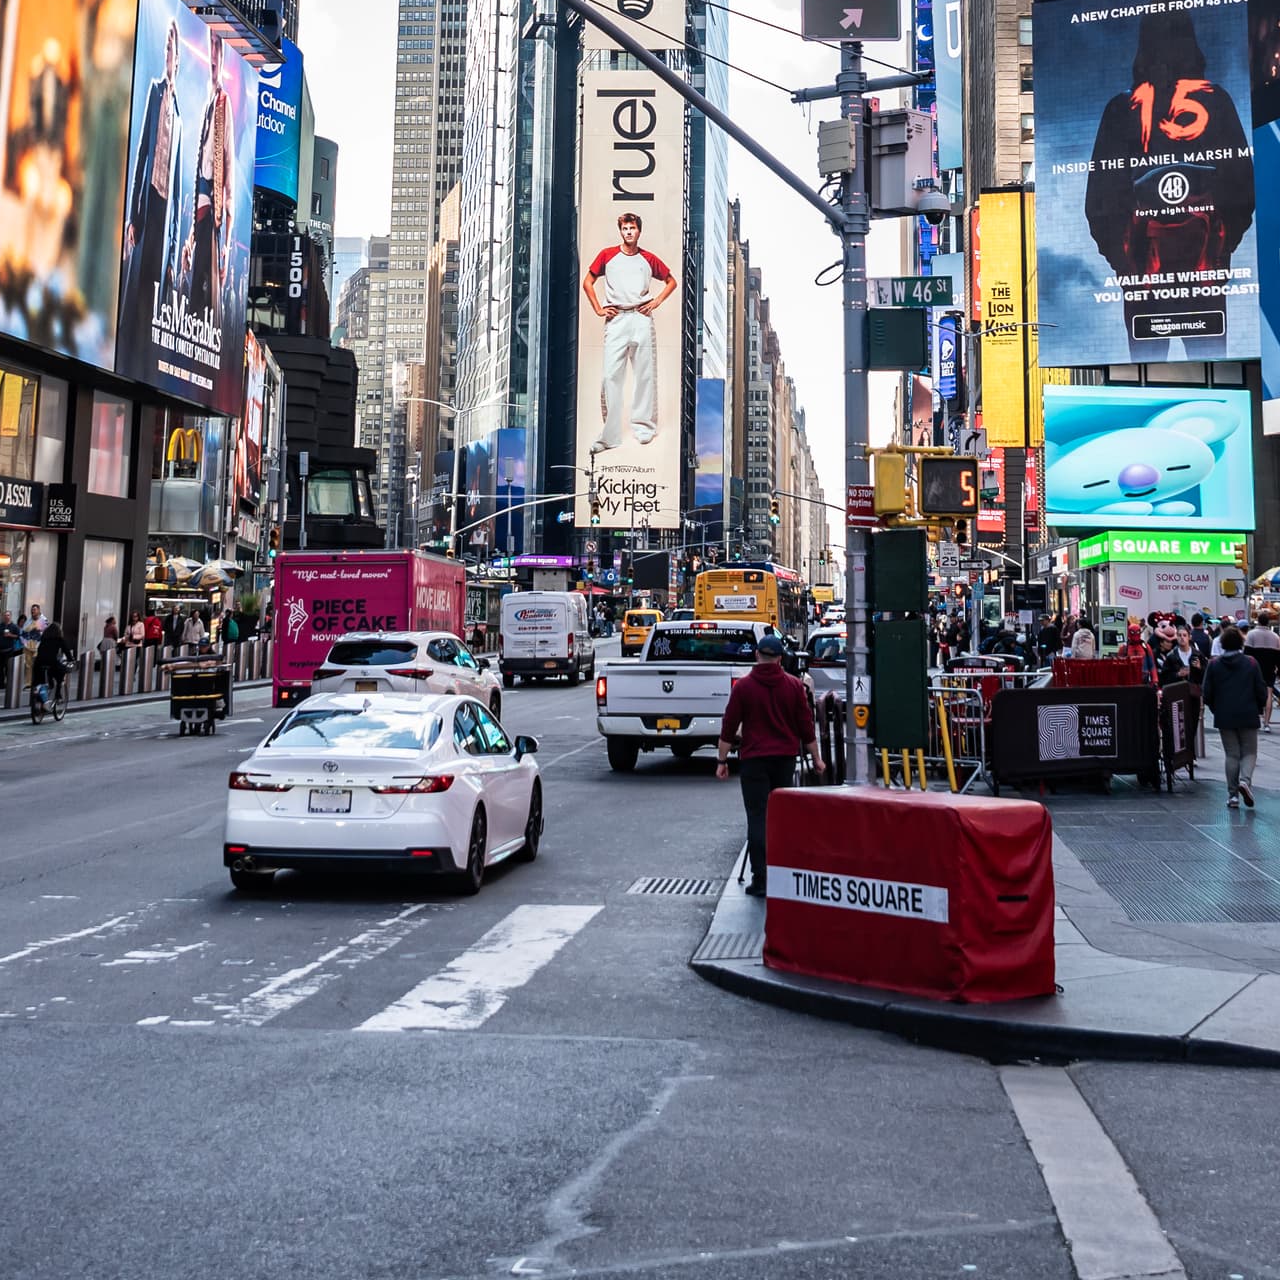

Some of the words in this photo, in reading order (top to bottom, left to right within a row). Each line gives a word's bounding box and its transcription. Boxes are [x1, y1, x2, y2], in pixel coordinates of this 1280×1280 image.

[1071, 13, 1079, 24] A
[1081, 10, 1109, 22] NEW
[1111, 3, 1166, 18] CHAPTER
[260, 90, 296, 120] Channel
[1130, 79, 1215, 153] 15
[596, 89, 657, 201] ruel
[1052, 160, 1096, 175] INSIDE
[1100, 157, 1125, 170] THE
[1130, 153, 1179, 168] DANIEL
[1183, 148, 1233, 163] MARSH
[1135, 208, 1159, 218] forty
[1160, 206, 1186, 217] eight
[1188, 203, 1215, 213] hours
[289, 236, 303, 298] 1500
[1104, 272, 1175, 288] AVAILABLE
[1177, 267, 1252, 283] WHEREVER
[894, 282, 906, 303] W
[912, 281, 932, 303] 46
[936, 279, 948, 293] St
[991, 287, 1011, 298] THE
[1093, 292, 1122, 304] YOU
[1124, 289, 1150, 302] GET
[1151, 286, 1190, 300] YOUR
[152, 281, 172, 331] Les
[171, 289, 221, 353] Misérables
[987, 301, 1014, 318] LION
[984, 319, 1018, 338] KING
[1150, 323, 1181, 334] amazon
[1181, 320, 1207, 330] music
[941, 362, 955, 370] TACO
[941, 368, 954, 377] BELL
[601, 465, 615, 474] The
[615, 465, 632, 474] New
[632, 465, 655, 474] Album
[5, 483, 33, 508] ASSN.
[597, 478, 657, 499] Kicking
[848, 489, 857, 498] NO
[961, 470, 976, 507] 5
[49, 499, 64, 508] U.S.
[623, 497, 661, 513] Feet
[848, 499, 872, 507] Anytime
[49, 506, 72, 516] POLO
[1113, 540, 1181, 554] SQUARE
[1190, 541, 1210, 554] BY
[941, 556, 958, 567] 25
[1156, 574, 1181, 582] SOKO
[1183, 574, 1210, 583] GLAM
[416, 586, 433, 608] MOVE
[434, 590, 445, 610] LIKE
[445, 592, 451, 611] A
[311, 599, 367, 614] PIECE
[311, 617, 338, 631] OF
[342, 616, 397, 631] CAKE
[1085, 716, 1109, 726] TIMES
[1081, 727, 1112, 737] SQUARE
[1084, 738, 1111, 747] ALLIANCE
[792, 871, 842, 903] TIMES
[847, 880, 923, 914] SQUARE
